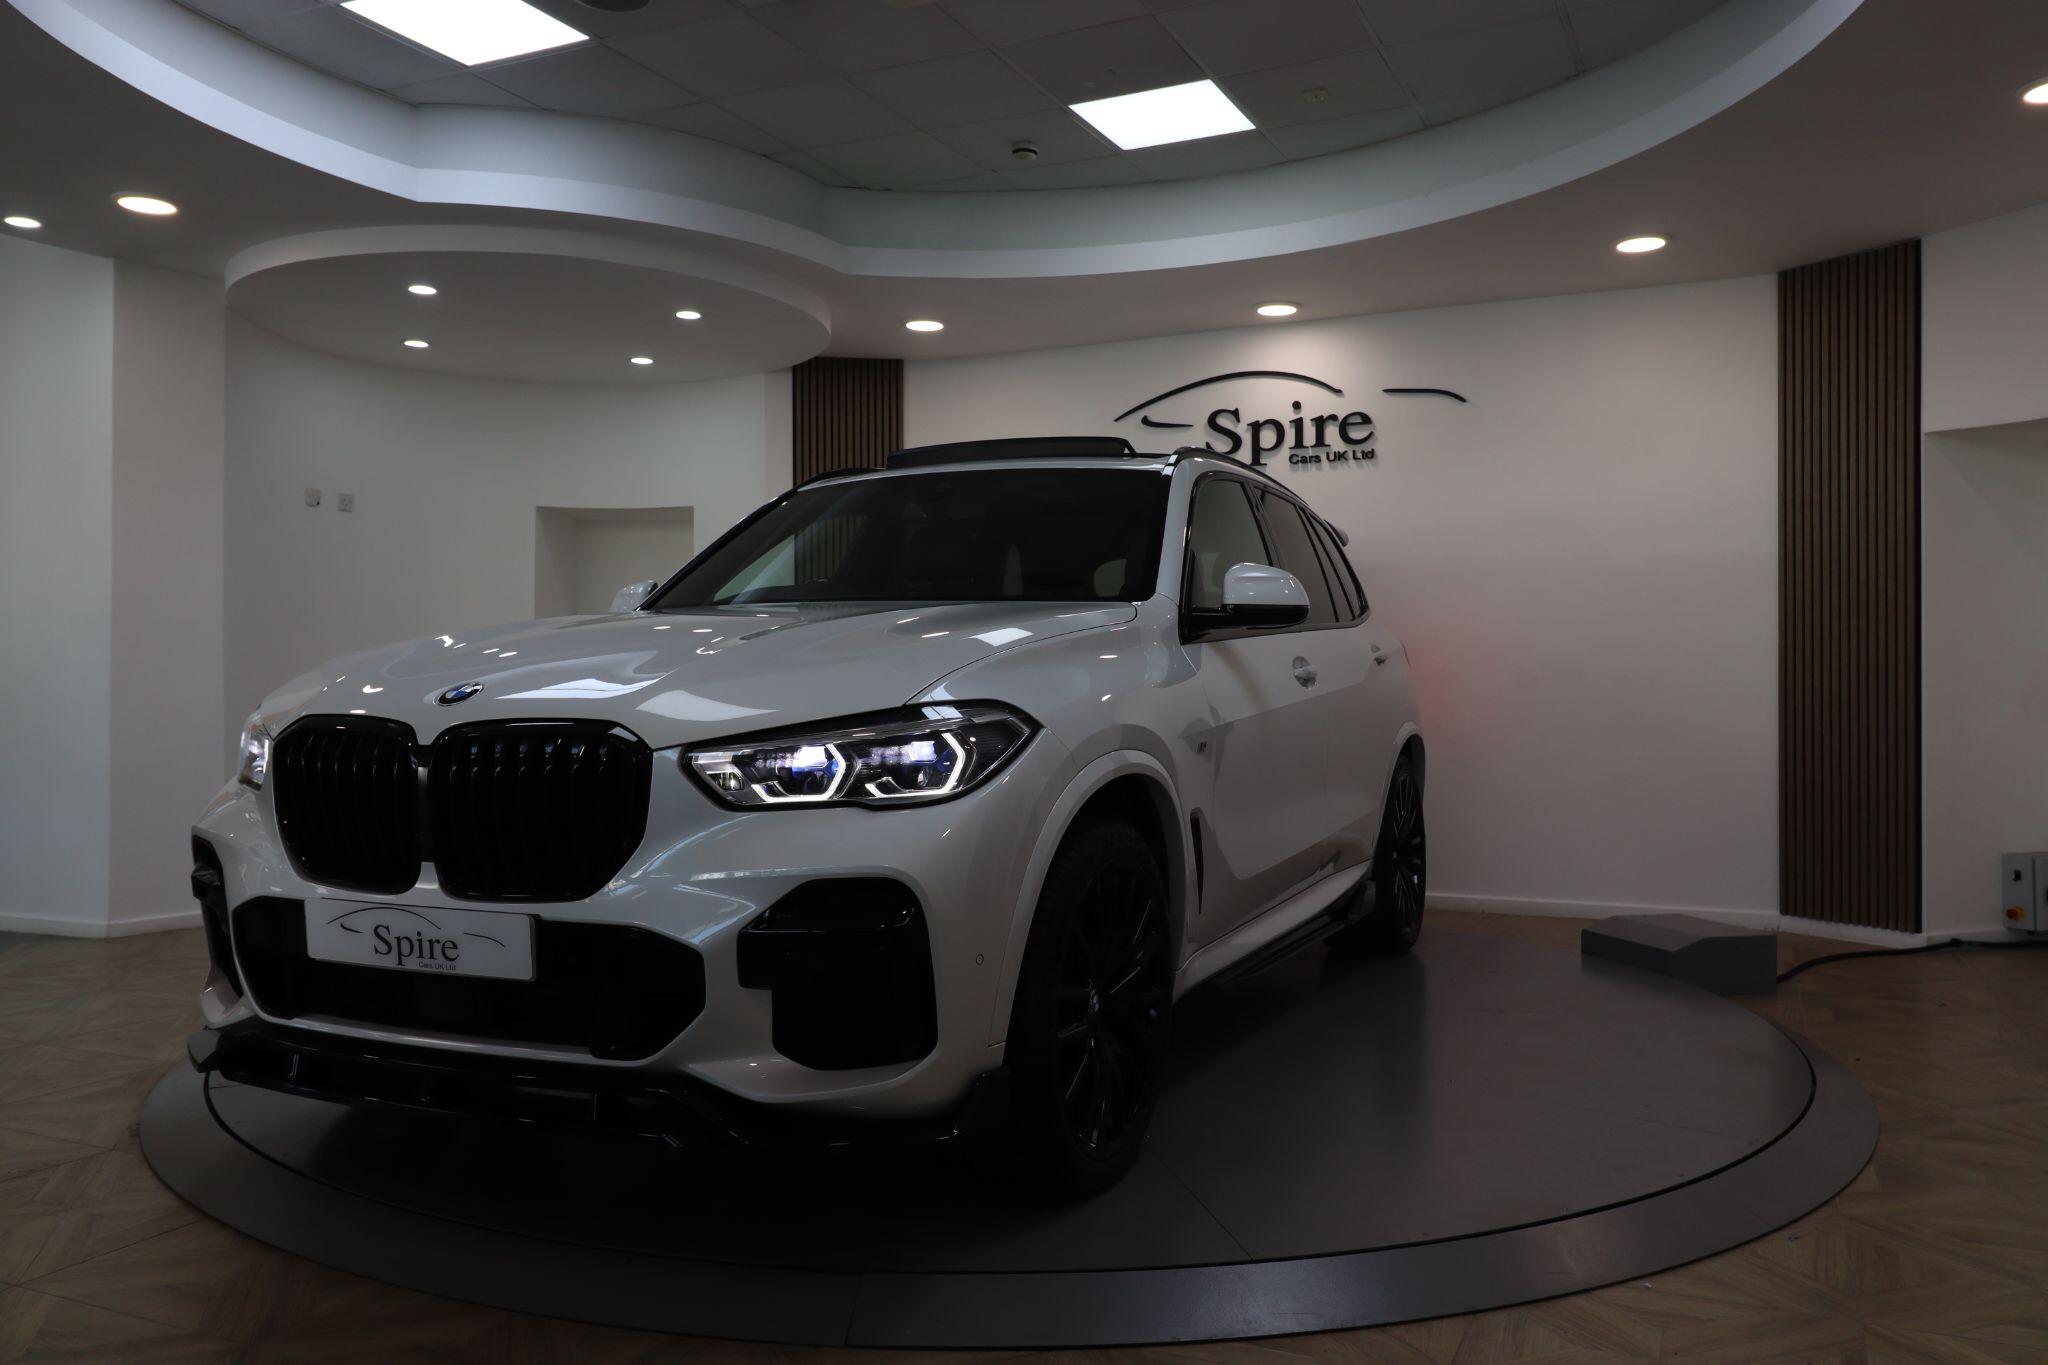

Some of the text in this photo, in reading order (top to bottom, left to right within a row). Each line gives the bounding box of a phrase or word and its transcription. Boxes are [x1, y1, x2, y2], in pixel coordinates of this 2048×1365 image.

[1205, 400, 1374, 467] Spire
[1288, 448, 1375, 465] Cars UK Ltd
[373, 924, 460, 966] Spire
